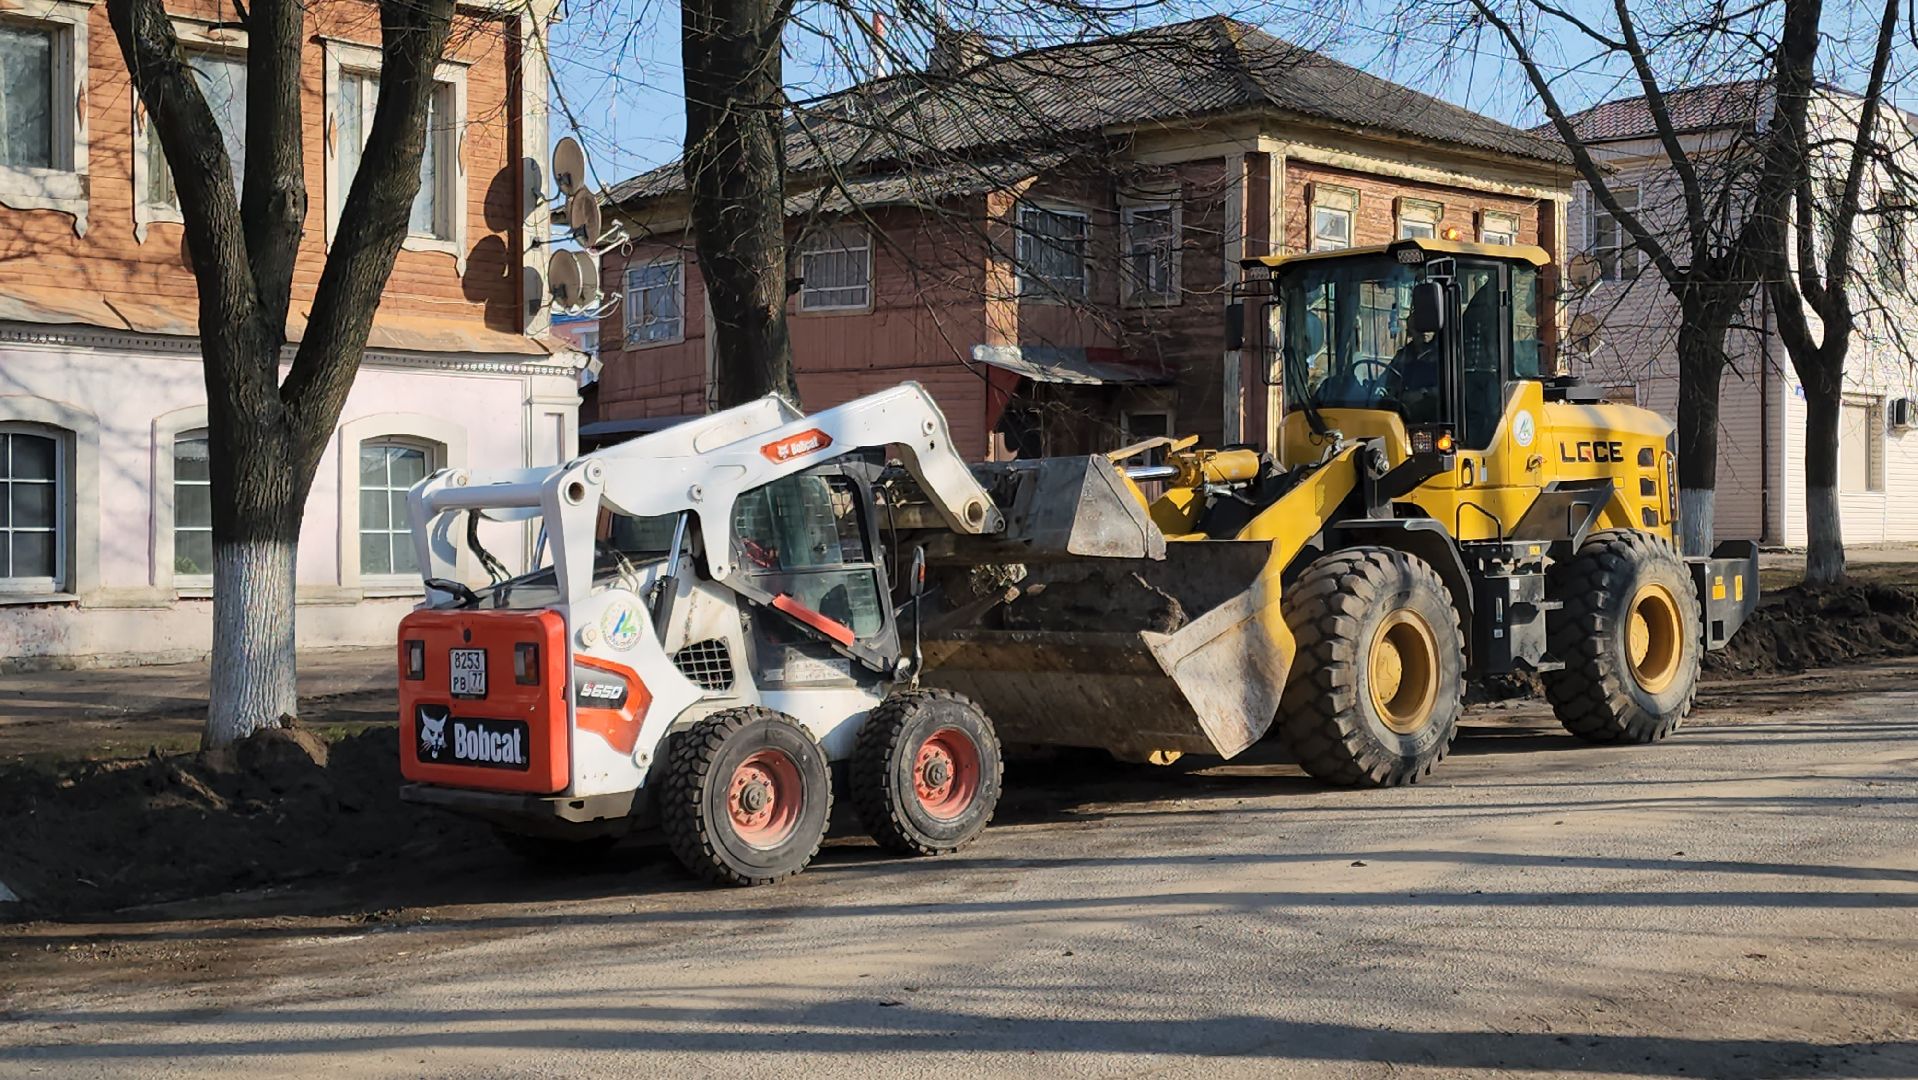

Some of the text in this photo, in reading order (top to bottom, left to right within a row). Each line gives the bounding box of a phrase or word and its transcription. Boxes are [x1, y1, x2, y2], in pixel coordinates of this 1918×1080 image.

[455, 652, 480, 669] 8253
[472, 672, 482, 687] 77
[580, 683, 623, 699] S650
[454, 723, 522, 764] Bobcat
